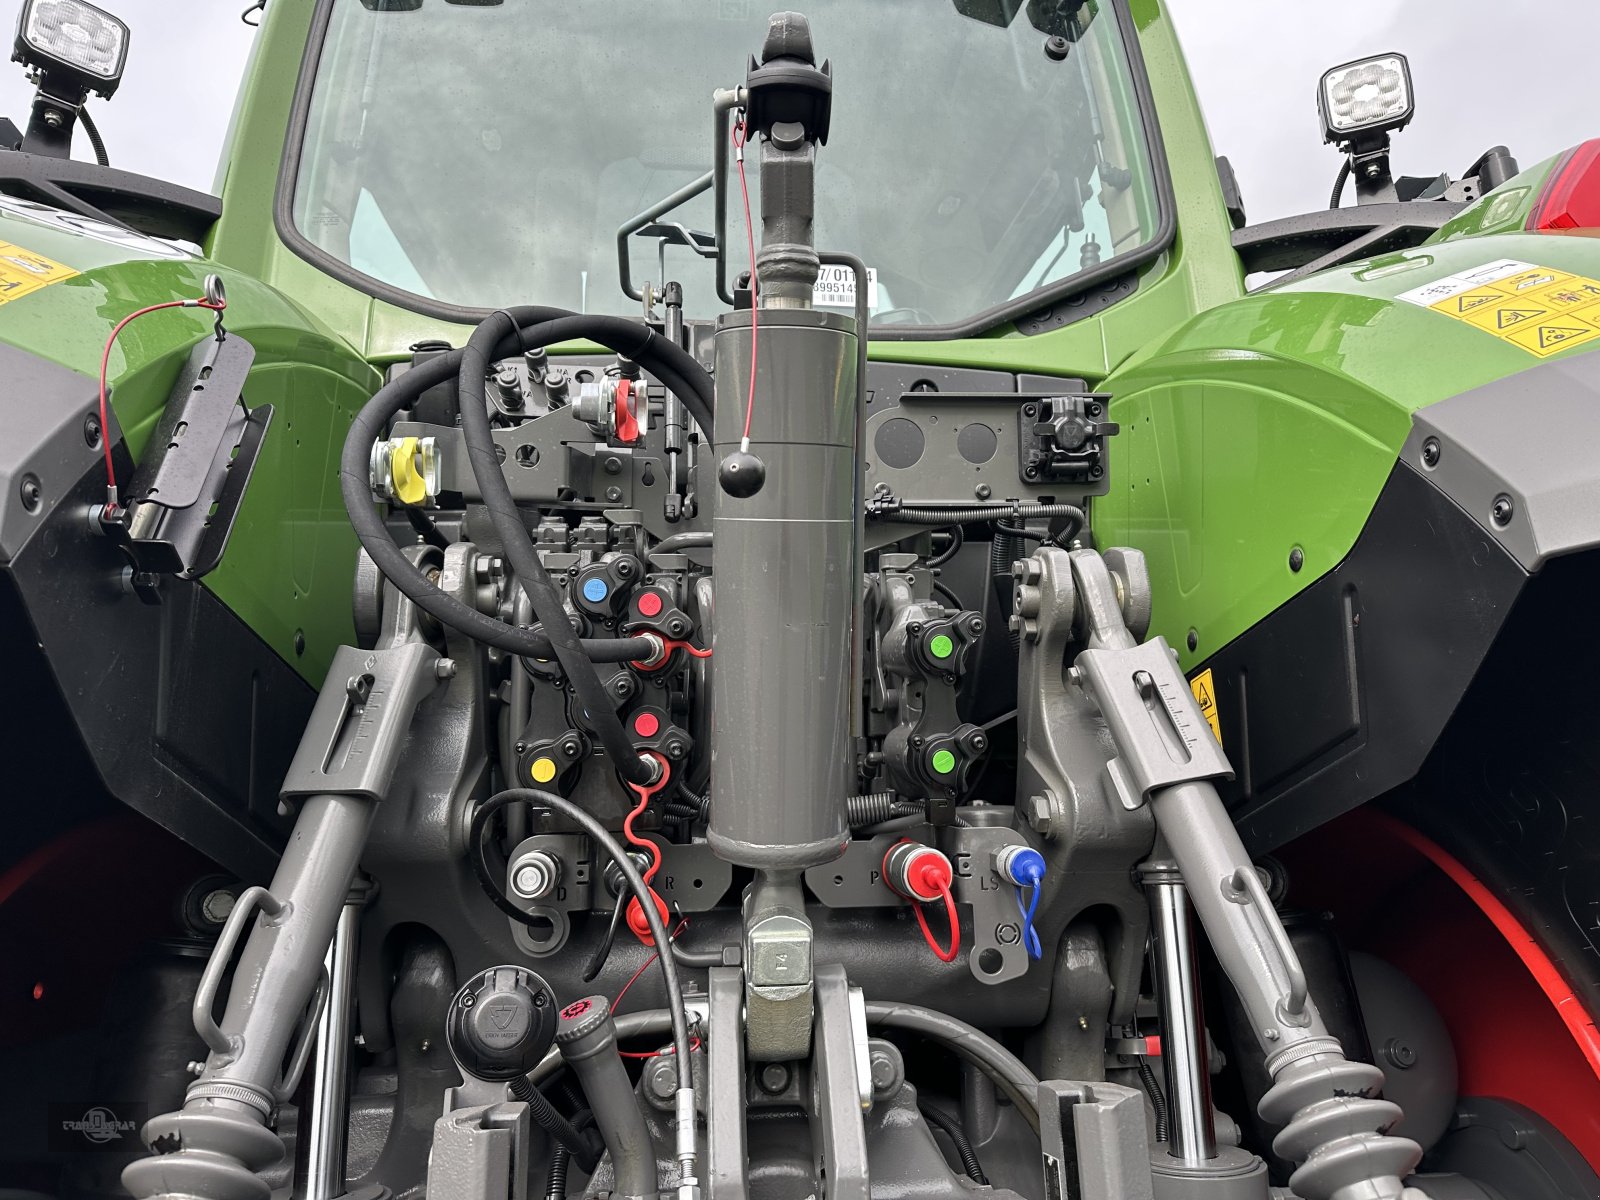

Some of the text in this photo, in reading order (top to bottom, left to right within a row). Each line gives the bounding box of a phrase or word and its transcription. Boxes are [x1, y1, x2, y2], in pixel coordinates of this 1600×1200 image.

[665, 876, 674, 890] R
[870, 870, 880, 885] P
[980, 876, 999, 891] LS
[556, 886, 567, 902] D
